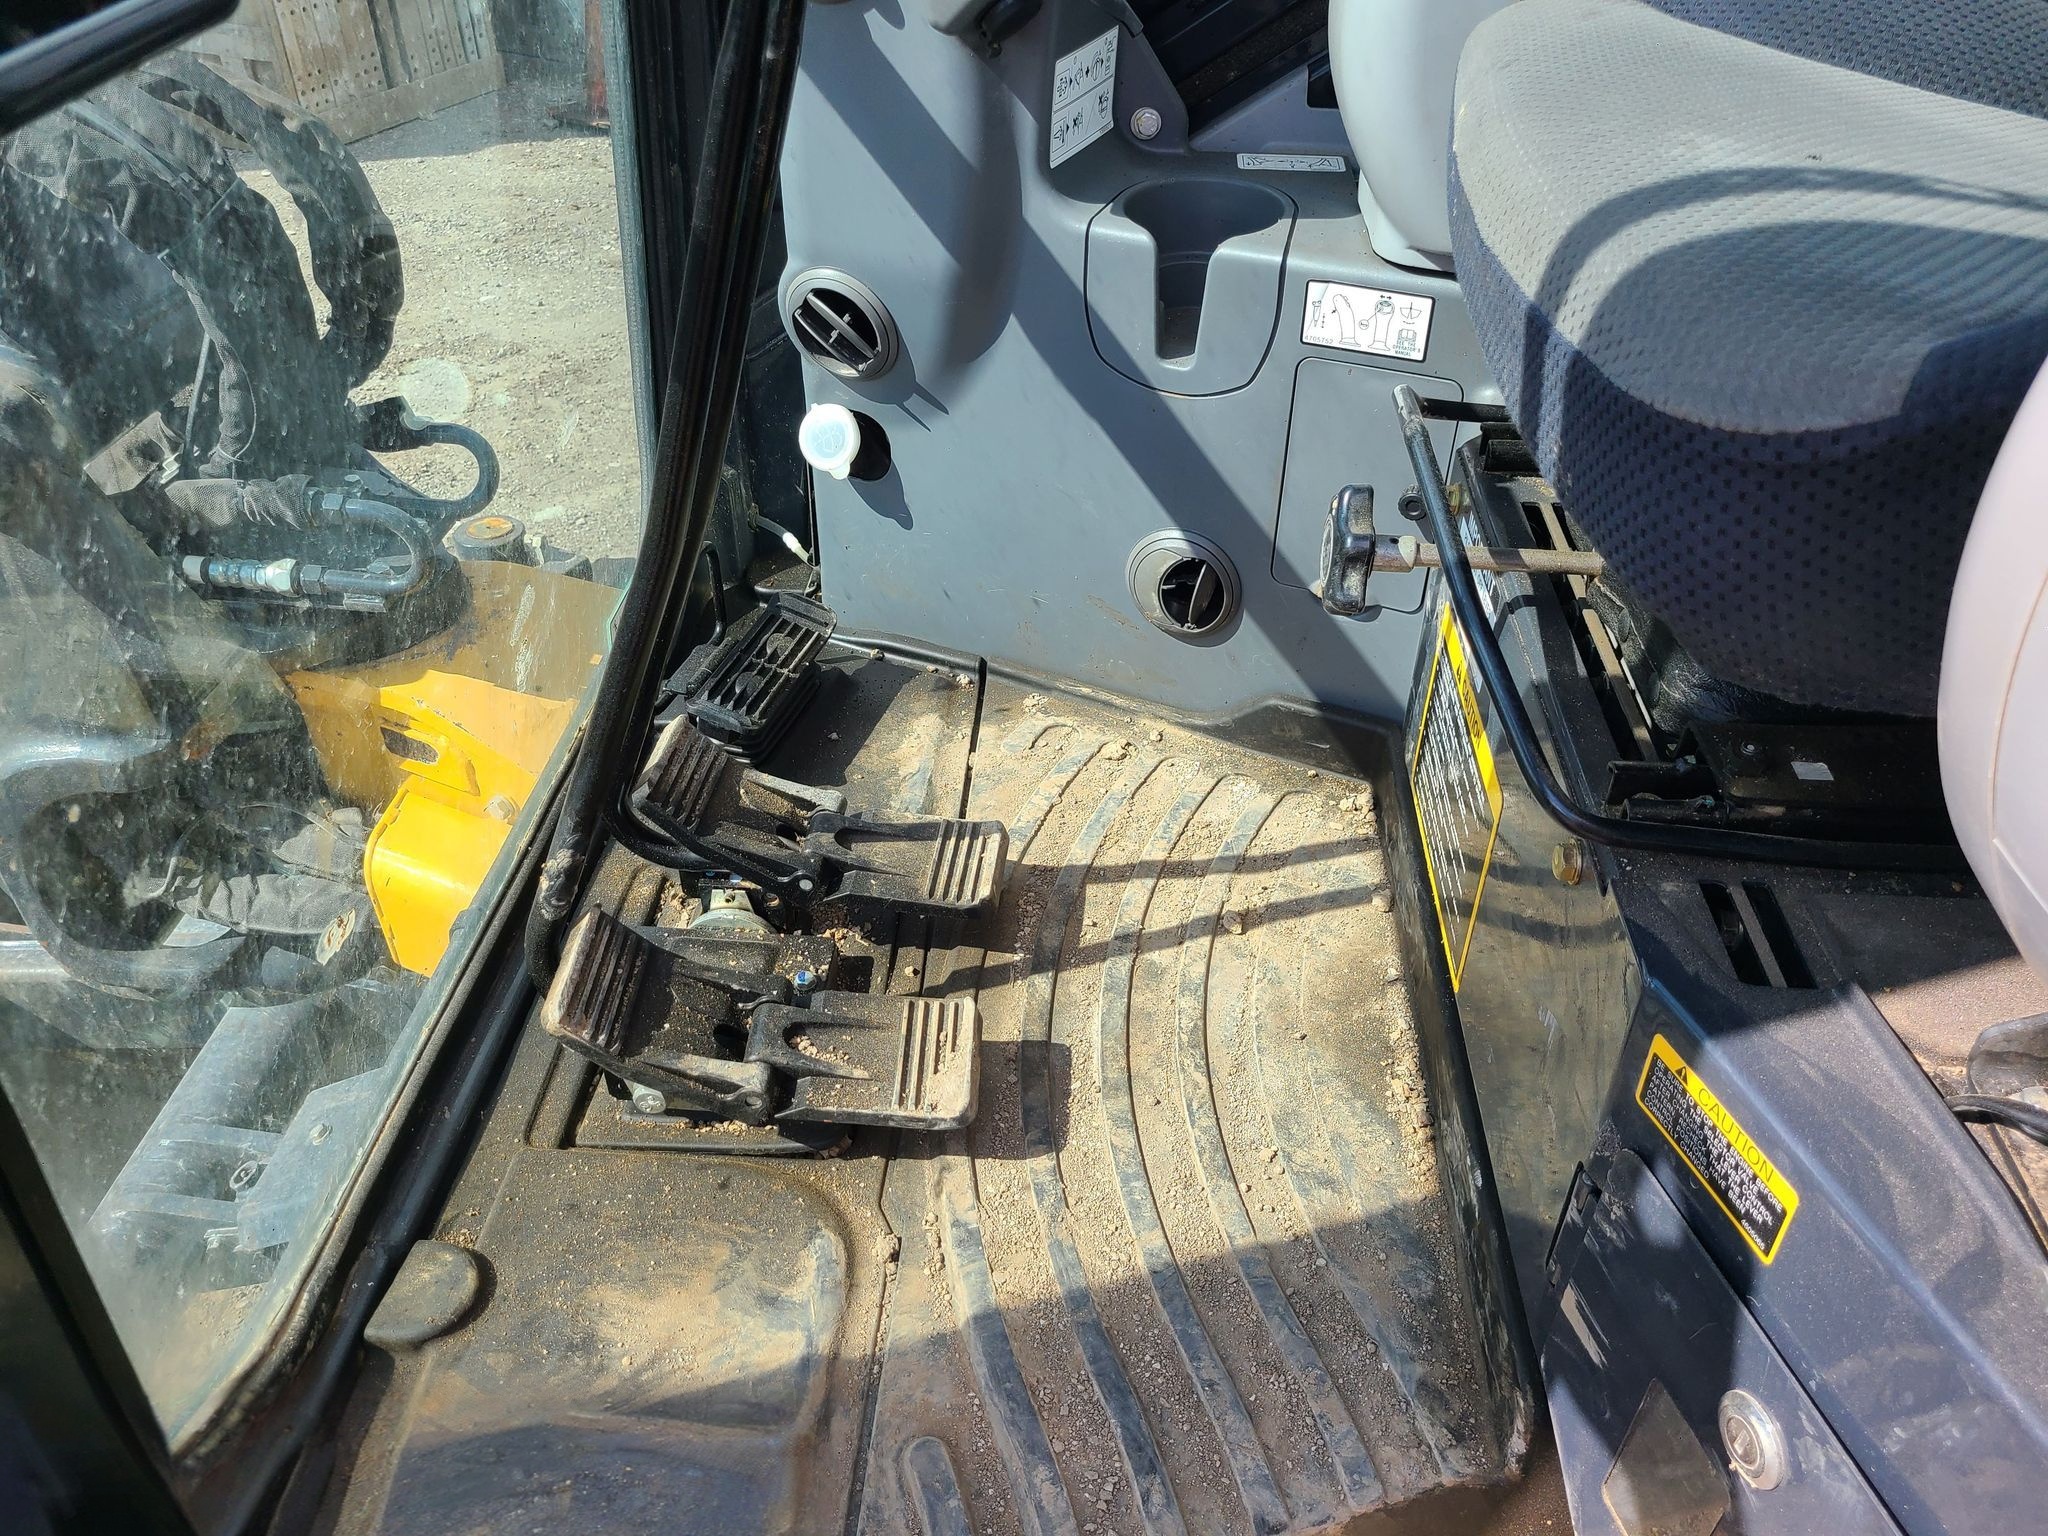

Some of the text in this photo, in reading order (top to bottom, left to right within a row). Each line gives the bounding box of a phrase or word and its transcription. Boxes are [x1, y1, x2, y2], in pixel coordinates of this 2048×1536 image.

[1463, 679, 1480, 748] CAUTION
[1643, 1095, 1678, 1141] CORRECTLY
[1646, 1087, 1746, 1215] CONTROL POSITIONS HAVE BEEN
[1651, 1073, 1774, 1226] AFTER CHANGING THE LEVER CONTROL
[1653, 1065, 1687, 1109] OPERATING
[1688, 1107, 1701, 1127] THE
[1702, 1124, 1736, 1168] SELECTOR
[1656, 1057, 1783, 1213] BE SURE TO STOP THE ENGINE BEFORE
[1696, 1085, 1775, 1183] CAUTION
[1677, 1116, 1706, 1155] RECHECK
[1708, 1153, 1725, 1178] THAT
[1726, 1176, 1740, 1197] THE
[1741, 1194, 1763, 1225] LEVER
